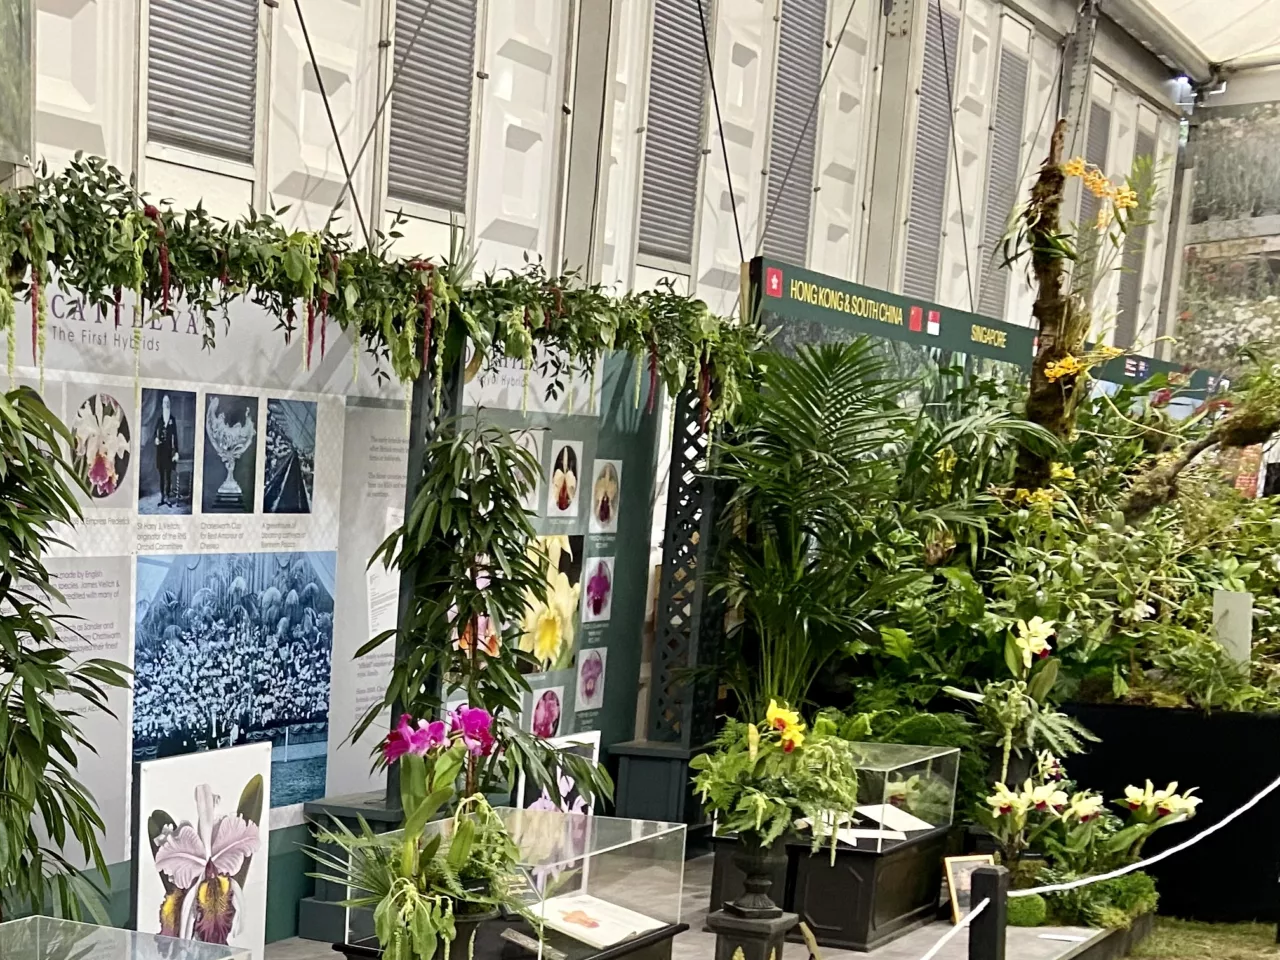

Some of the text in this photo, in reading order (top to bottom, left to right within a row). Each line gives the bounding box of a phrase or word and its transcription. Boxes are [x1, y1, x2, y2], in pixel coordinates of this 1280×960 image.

[790, 278, 904, 326] HONG KONG & SOUTH CHINA
[52, 325, 161, 352] The First Hybids
[970, 324, 1008, 349] SINGAPORE
